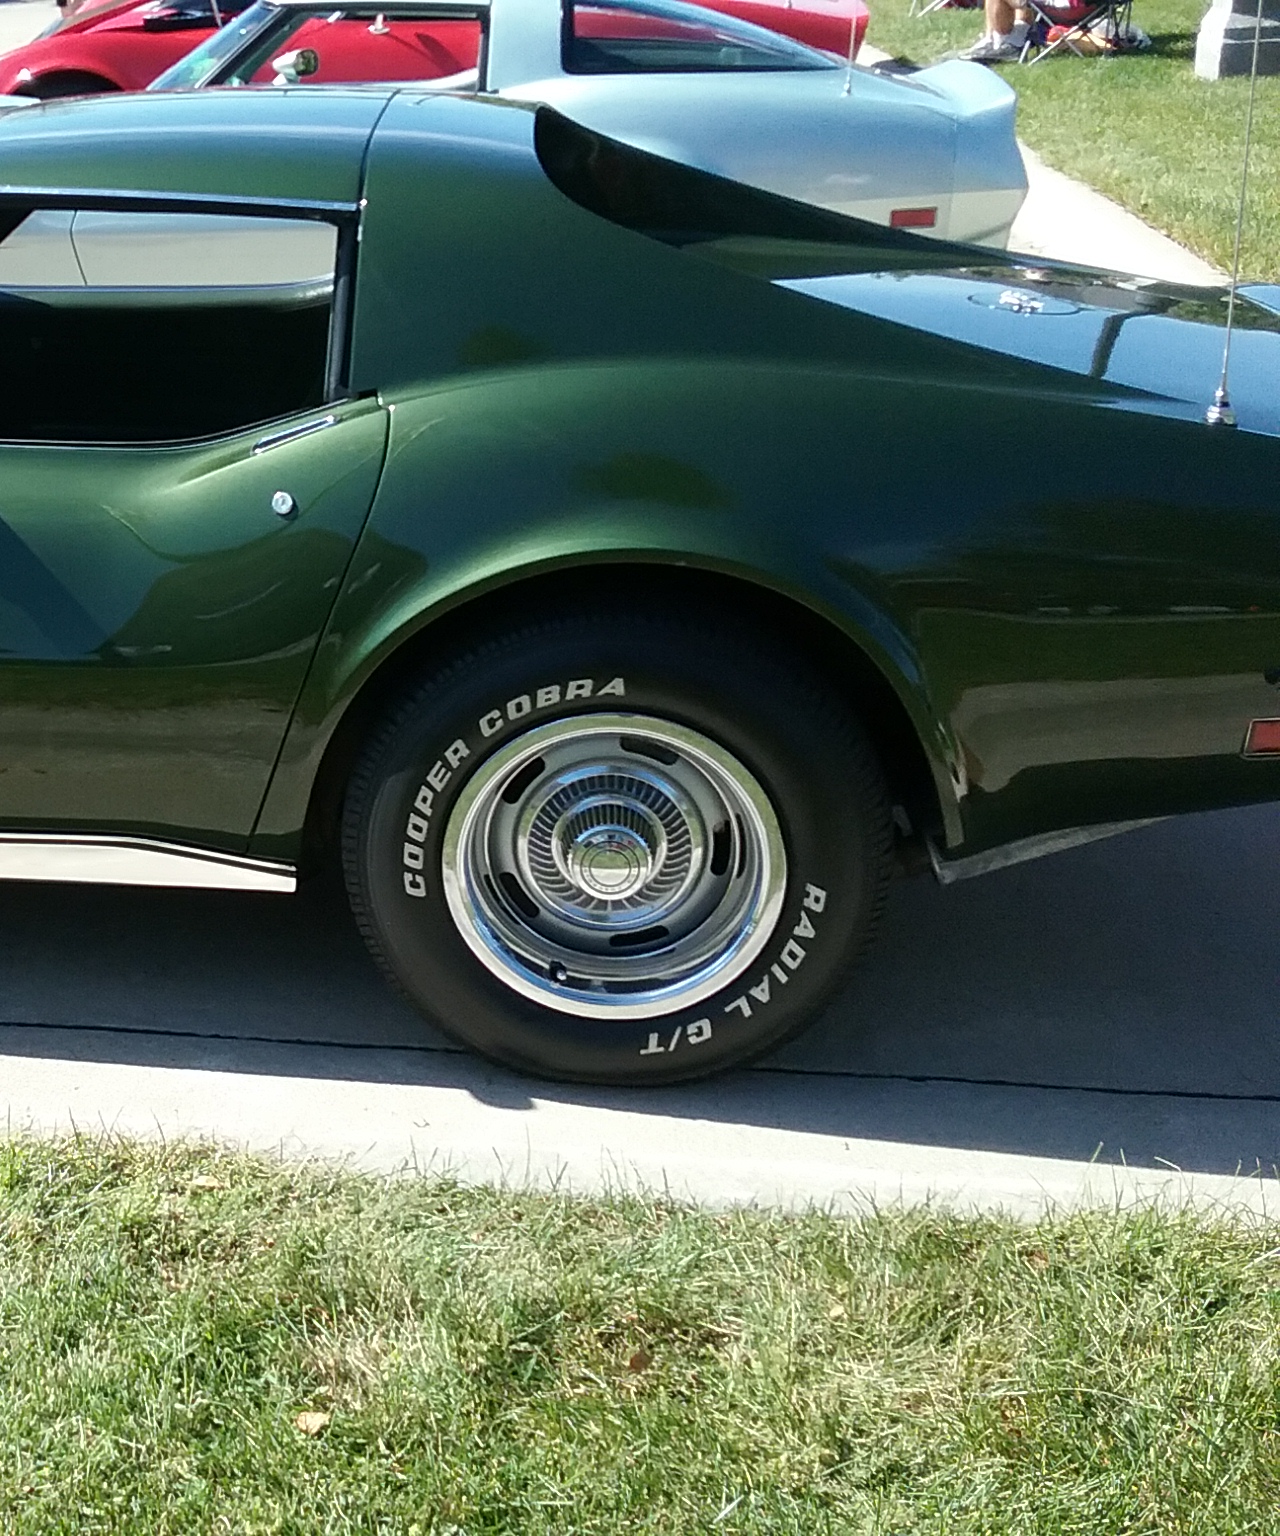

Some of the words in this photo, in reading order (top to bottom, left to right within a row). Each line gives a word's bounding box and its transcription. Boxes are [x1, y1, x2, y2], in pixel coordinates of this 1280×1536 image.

[403, 738, 471, 898] COOPER
[478, 677, 625, 738] COBRA
[724, 882, 827, 1018] RADIAL
[639, 1018, 712, 1055] G/T
